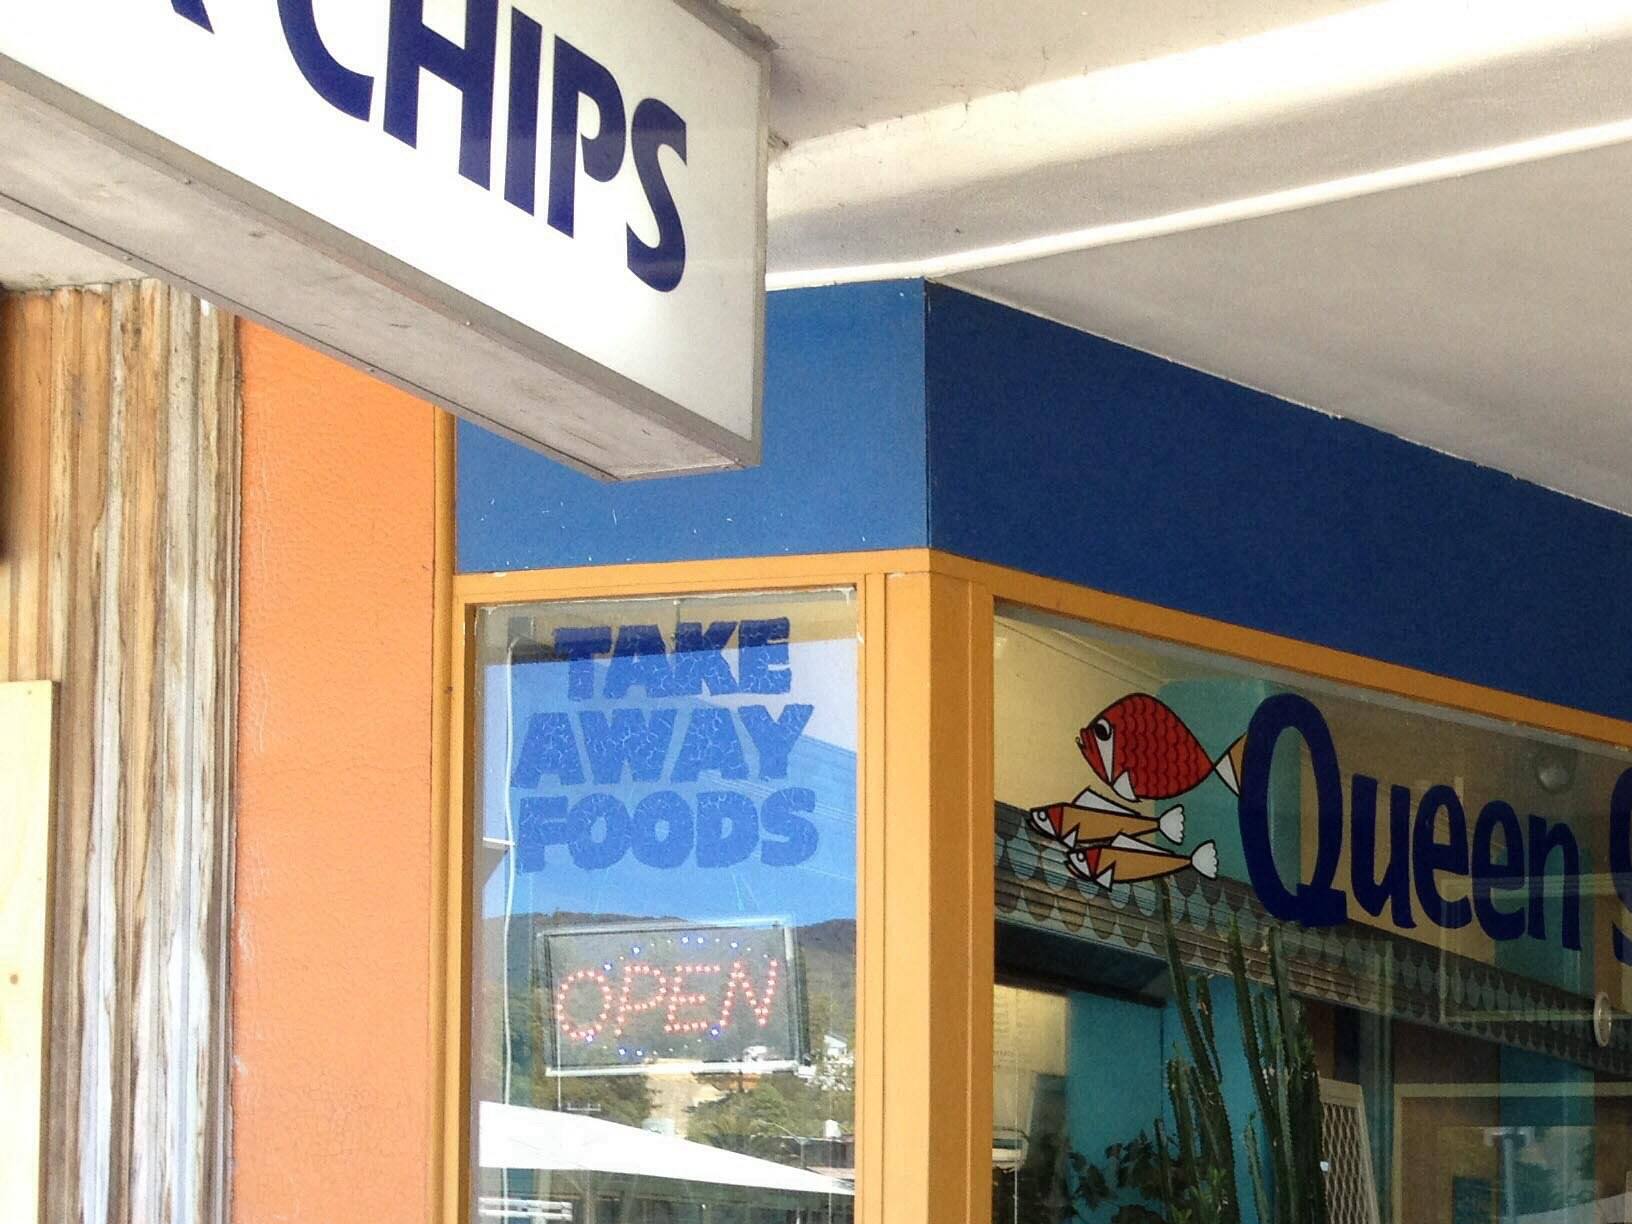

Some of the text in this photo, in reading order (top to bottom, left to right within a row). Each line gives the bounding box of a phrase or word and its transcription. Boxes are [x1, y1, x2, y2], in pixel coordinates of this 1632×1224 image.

[277, 0, 688, 293] CHIPS
[553, 617, 792, 701] TAKE
[511, 703, 814, 788] AWAY
[515, 787, 819, 874] FOODS
[1238, 692, 1582, 952] Queen
[556, 958, 780, 1042] OPEN
